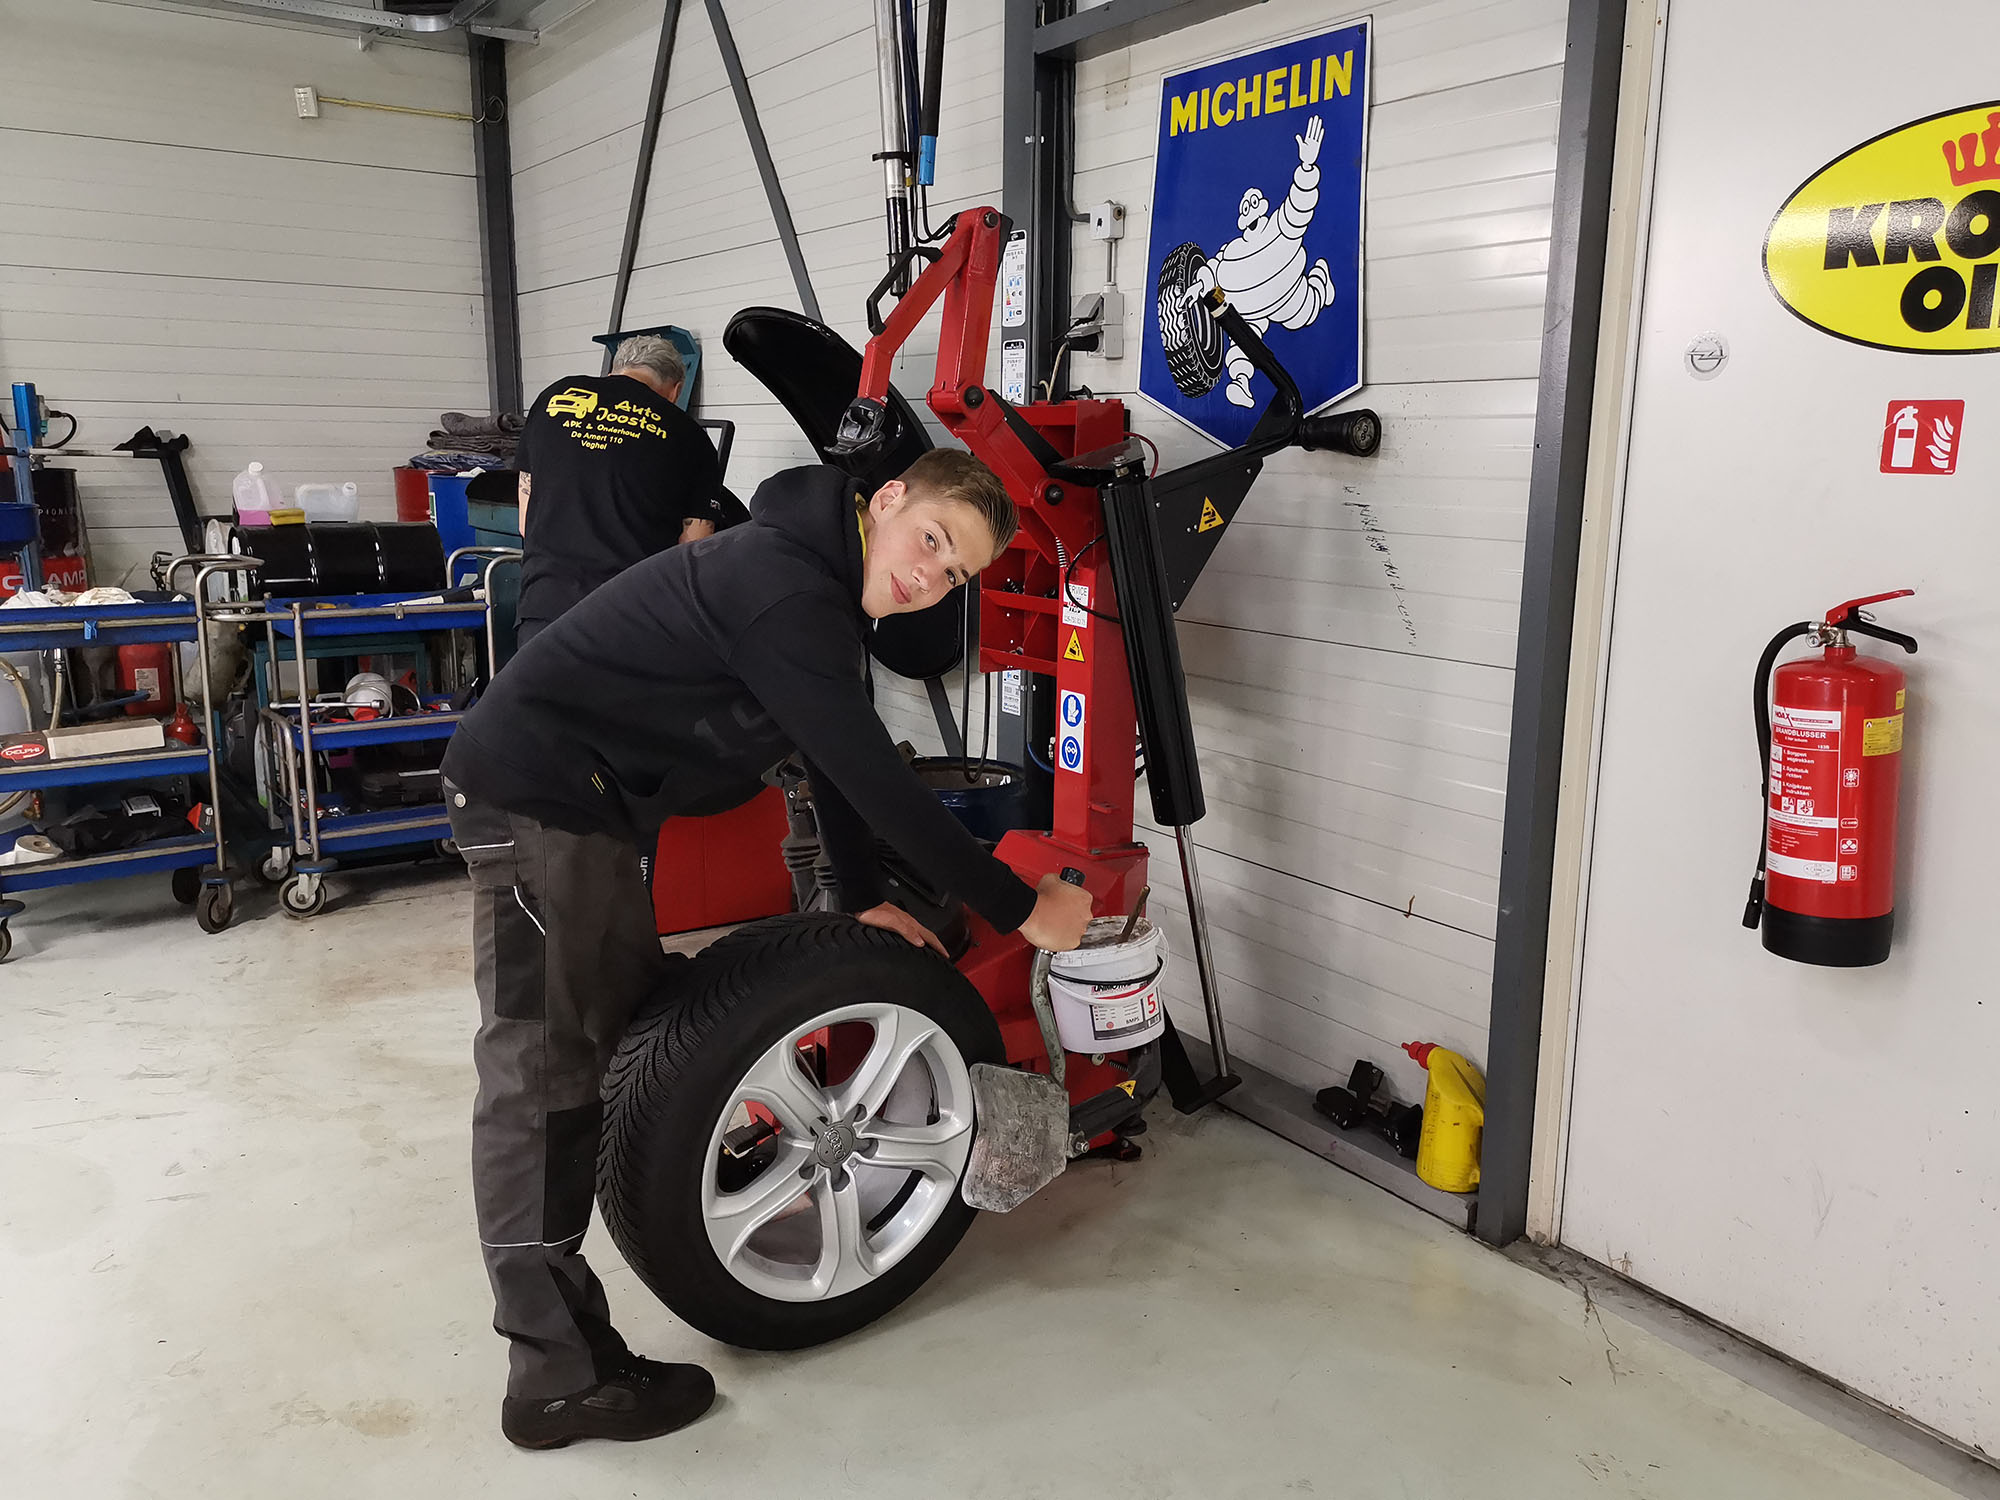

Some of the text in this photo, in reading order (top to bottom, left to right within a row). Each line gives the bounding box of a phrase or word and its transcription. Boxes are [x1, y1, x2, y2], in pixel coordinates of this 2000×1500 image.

[1170, 50, 1354, 137] MICHELIN
[614, 400, 662, 422] Auto
[562, 420, 641, 439] APK & Onderhoud
[596, 407, 667, 439] Joosten
[571, 431, 624, 444] De Amert 110
[581, 440, 608, 450] Veghel
[1775, 726, 1827, 739] BRANDBLUSSER
[5, 747, 41, 756] DELPHI
[1146, 993, 1156, 1014] 5
